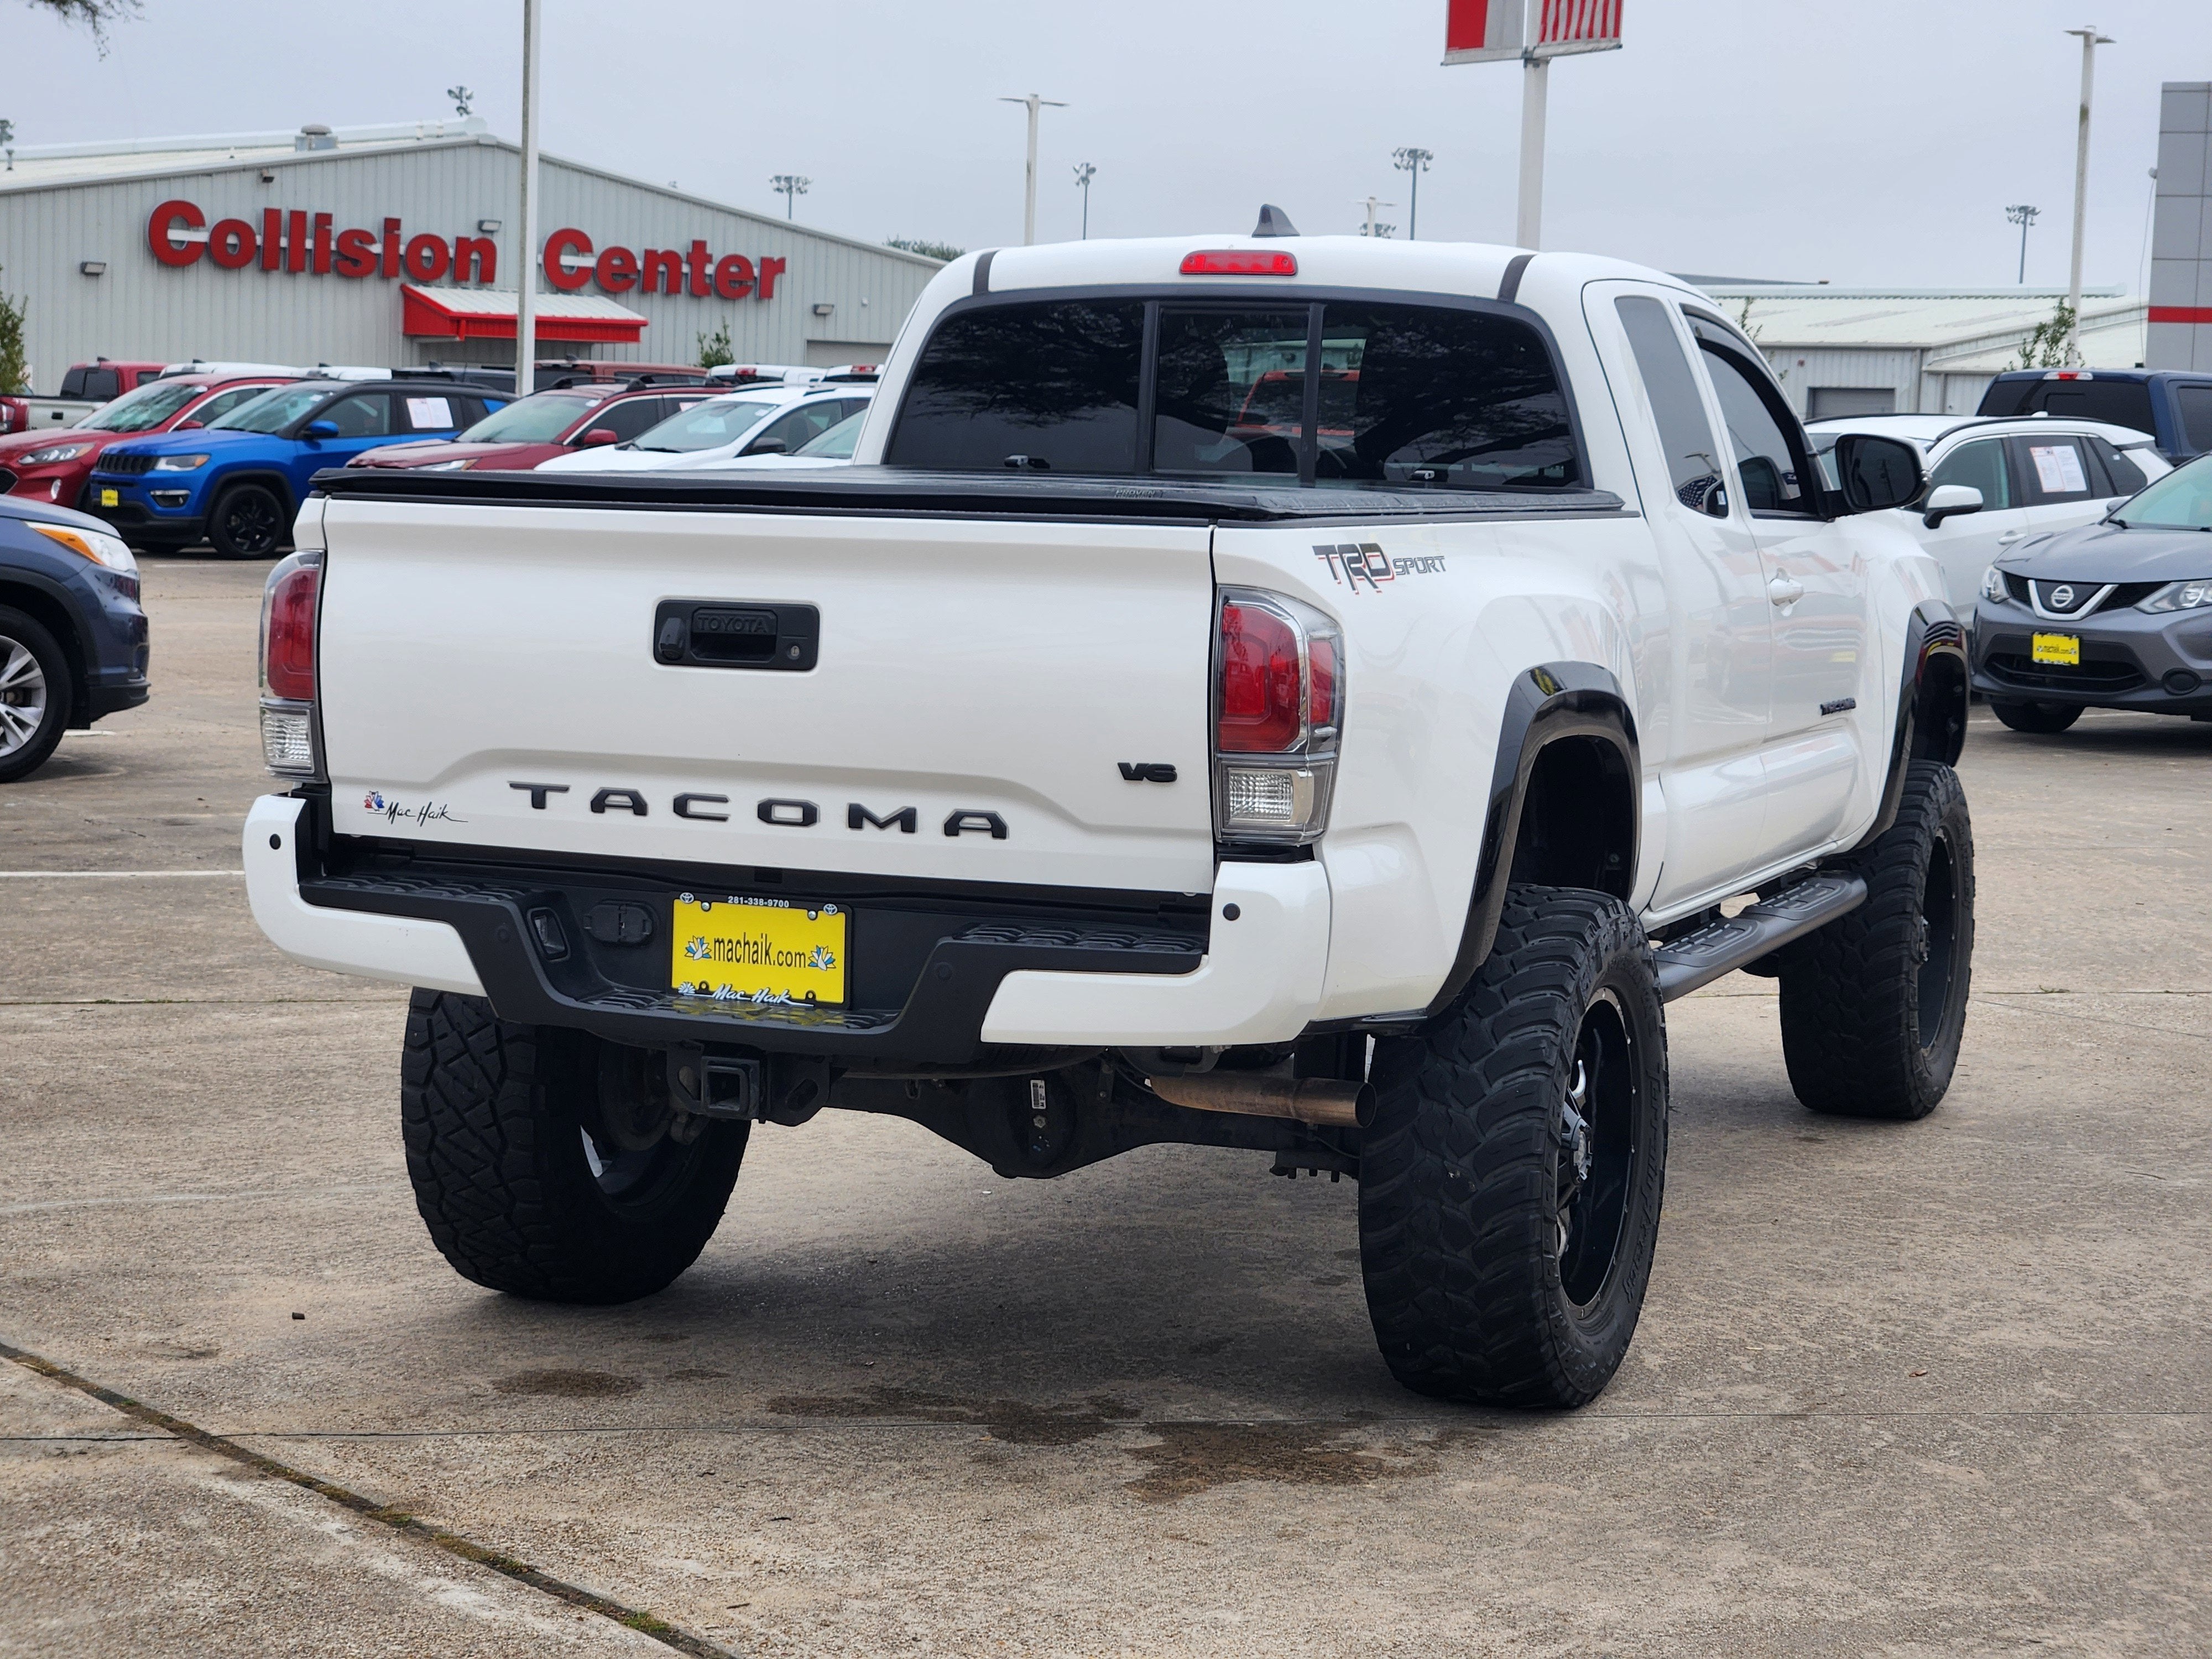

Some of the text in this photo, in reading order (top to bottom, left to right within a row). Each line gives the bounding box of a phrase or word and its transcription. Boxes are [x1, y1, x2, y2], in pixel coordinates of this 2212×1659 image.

[148, 199, 785, 300] Collision Center
[1312, 542, 1446, 594] TRD SPORT
[697, 616, 769, 633] TOYOTA
[1117, 762, 1177, 782] V6
[387, 801, 468, 827] Mac Haik
[507, 781, 1009, 840] TACOMA
[728, 895, 790, 908] 281-338-9700
[713, 932, 806, 969] machaik.com
[711, 983, 814, 1008] Mac Haik
